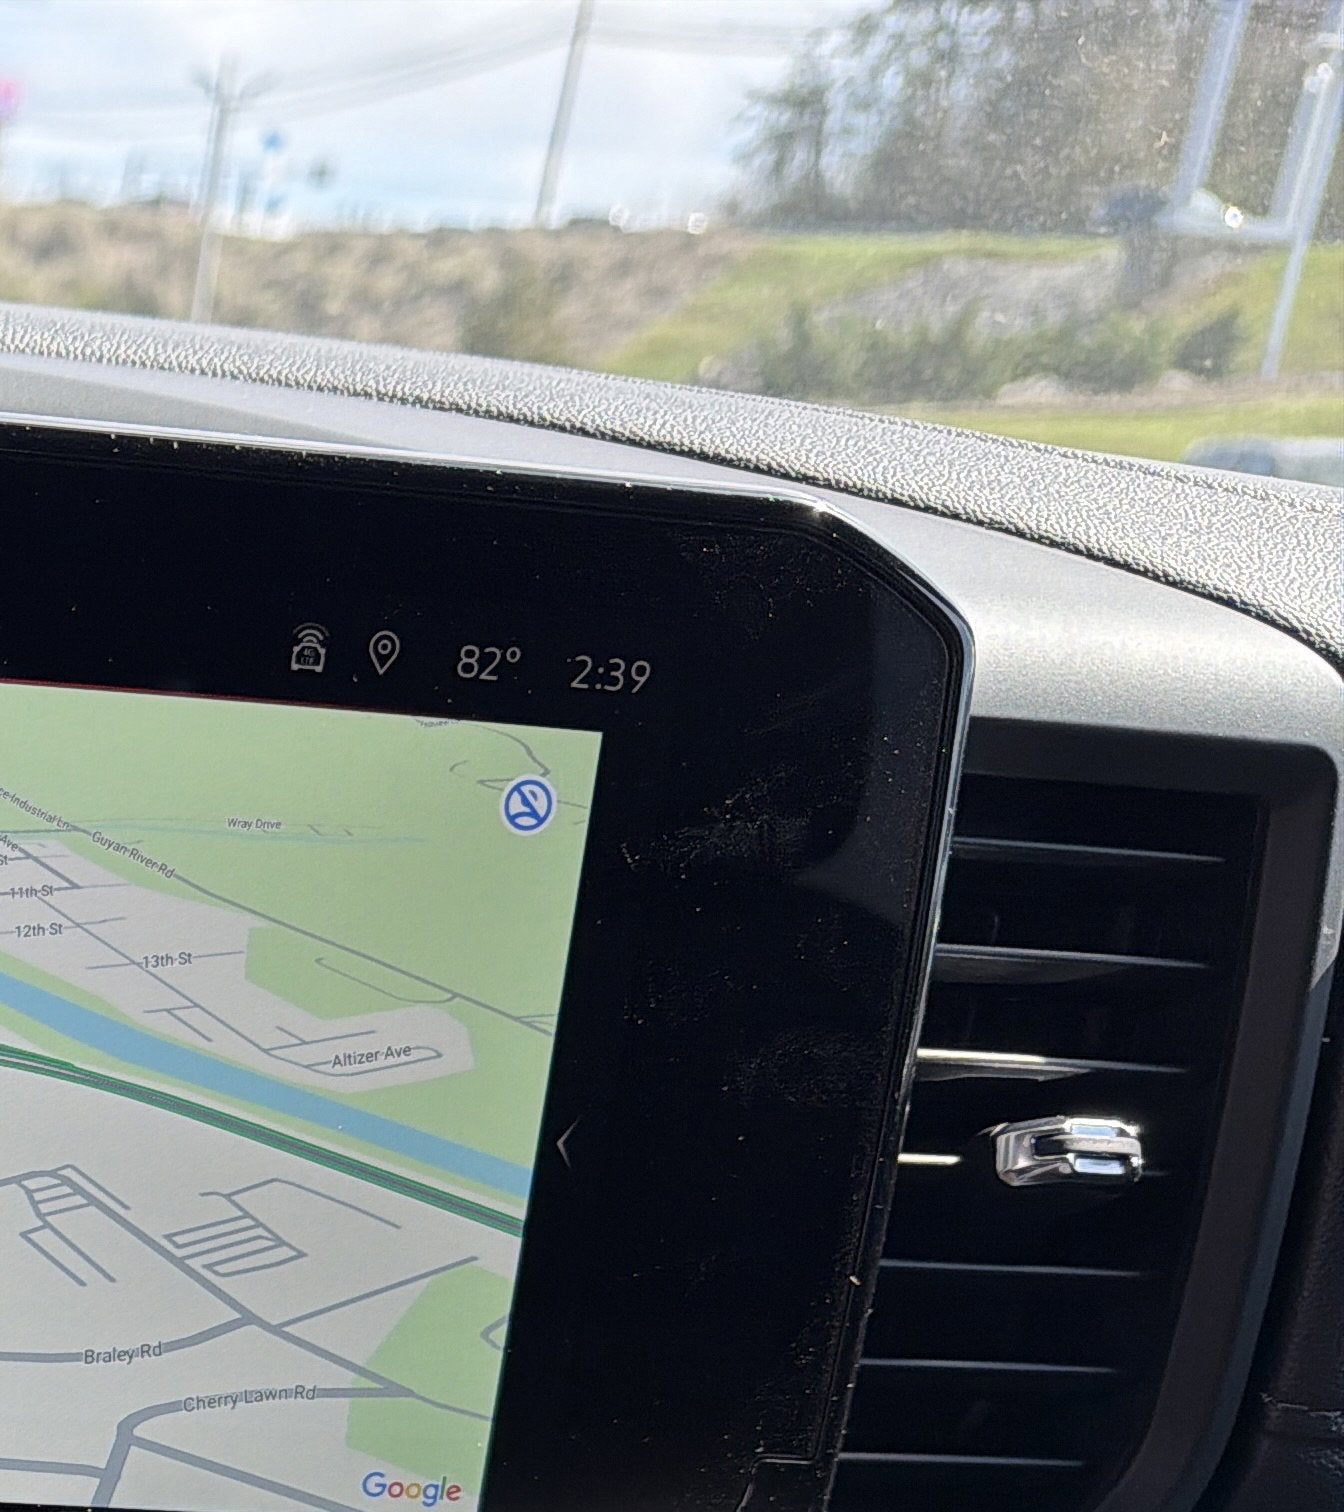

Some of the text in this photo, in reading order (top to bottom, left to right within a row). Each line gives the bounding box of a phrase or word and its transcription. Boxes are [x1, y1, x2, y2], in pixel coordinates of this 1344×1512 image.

[457, 645, 522, 681] 82°
[570, 655, 651, 693] 2:39
[11, 793, 61, 828] Industrial
[227, 817, 282, 831] Wray Drive
[92, 831, 176, 880] Guyan River Rd
[10, 884, 54, 899] 11th St
[14, 923, 63, 939] 12th St
[143, 951, 193, 969] 13th St
[331, 1044, 413, 1069] Altizer Ave
[84, 1341, 163, 1365] Braley Rd
[183, 1384, 317, 1413] Cherry Lawn Rd
[362, 1471, 462, 1507] Google
